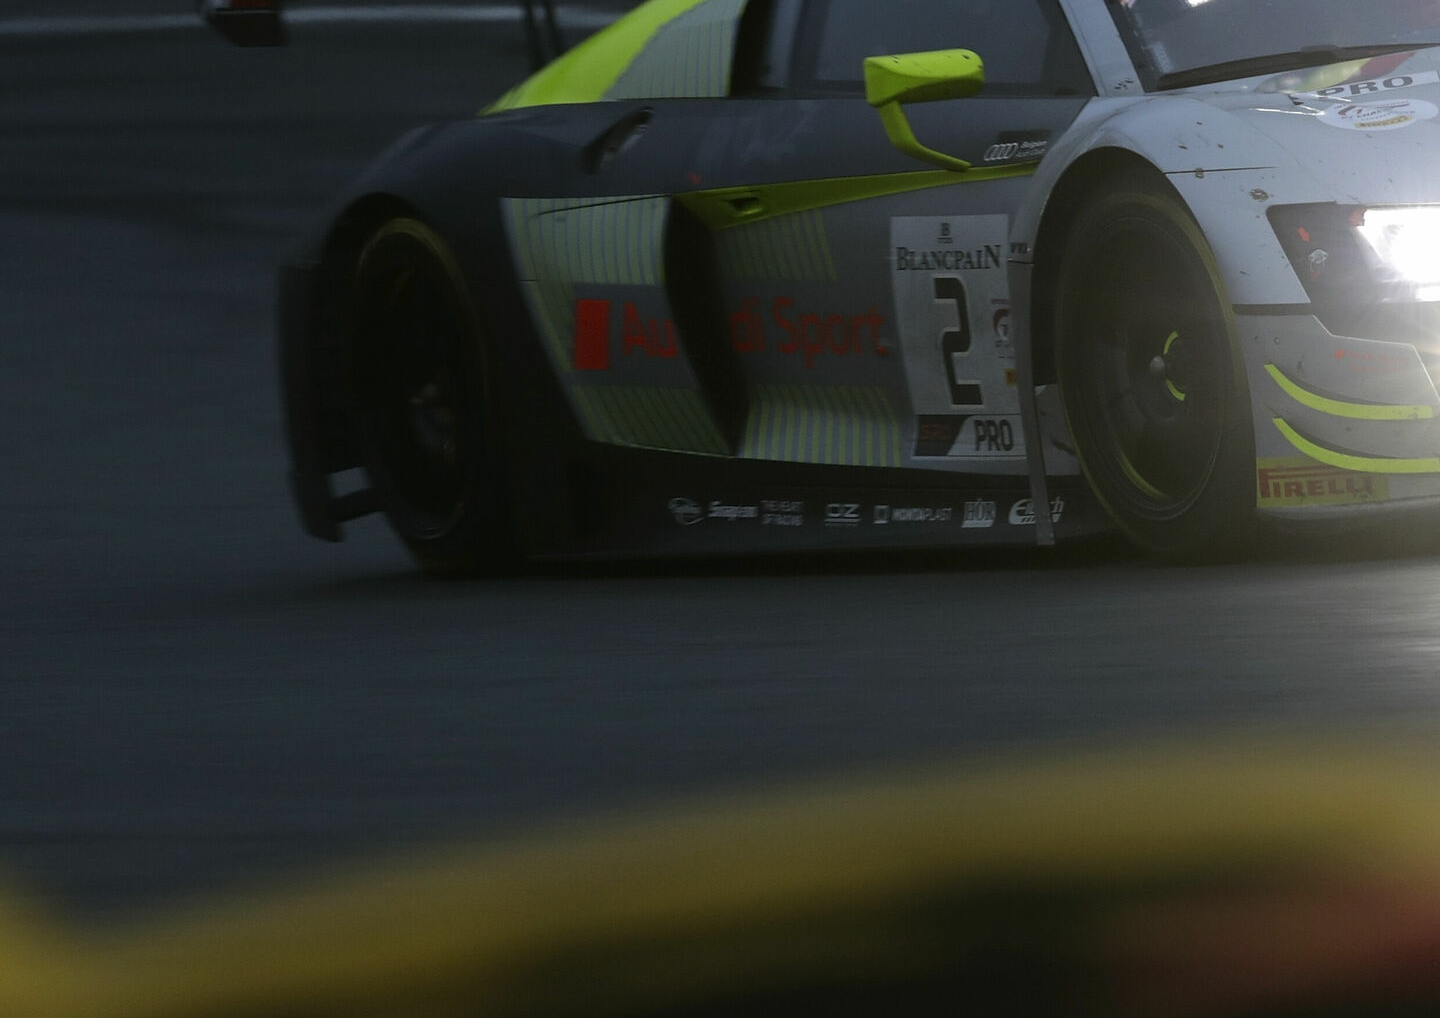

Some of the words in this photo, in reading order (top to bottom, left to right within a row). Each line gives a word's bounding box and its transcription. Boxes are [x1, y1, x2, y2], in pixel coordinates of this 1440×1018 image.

[1317, 76, 1414, 99] PRO
[896, 244, 1001, 271] BLANCPAIN
[622, 296, 769, 358] Audi
[773, 295, 894, 370] Sport
[933, 277, 983, 405] 2
[974, 419, 1013, 451] PRO
[1258, 466, 1374, 499] PIRELLI
